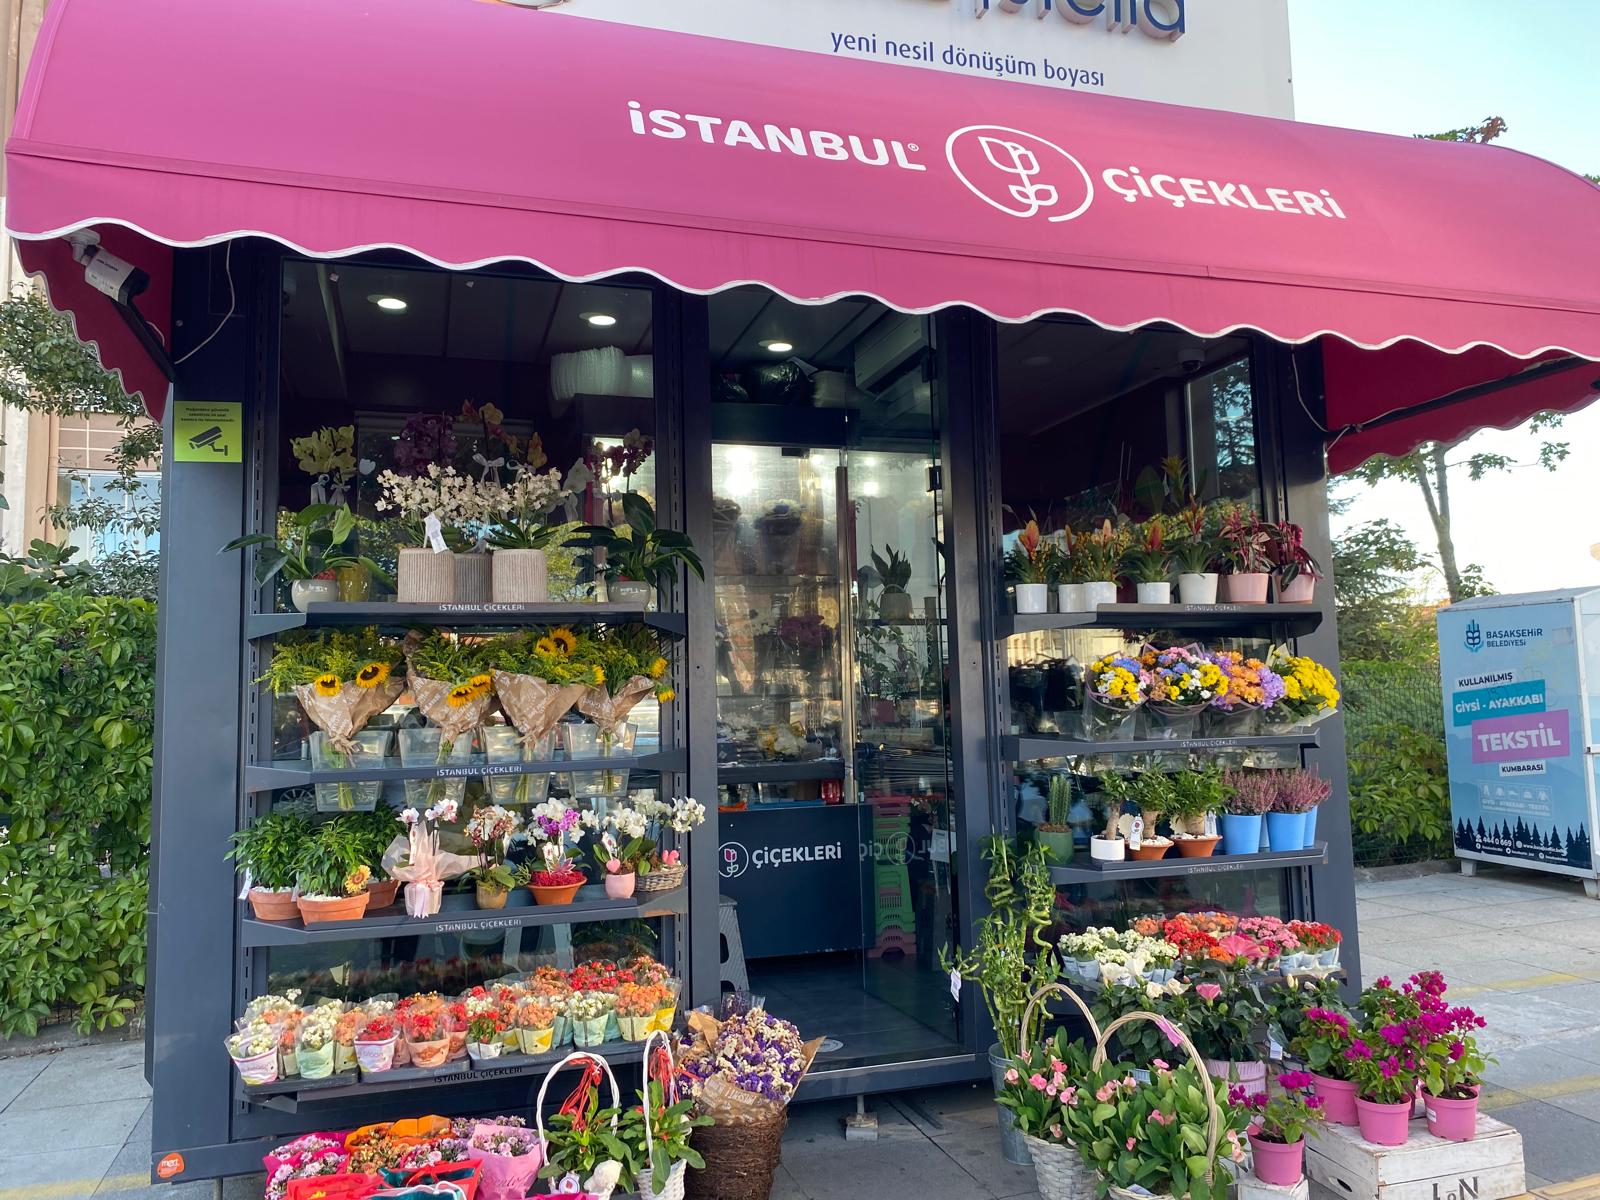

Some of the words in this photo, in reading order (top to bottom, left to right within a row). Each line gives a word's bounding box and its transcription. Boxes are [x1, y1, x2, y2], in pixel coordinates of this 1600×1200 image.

[831, 31, 877, 53] yeni
[885, 40, 934, 62] nesil
[942, 44, 1036, 77] dönüşüm
[1044, 58, 1105, 87] boyası
[1102, 165, 1347, 219] ÇİÇEKLERİ
[1458, 672, 1513, 687] KULLANILMIŞ
[1455, 698, 1480, 713] GİYSİ
[1488, 693, 1544, 710] AYAKKABI
[1478, 722, 1561, 752] TEKSTİL
[1501, 763, 1544, 773] KUMBARASI
[752, 841, 842, 869] ÇİÇEKLERİ
